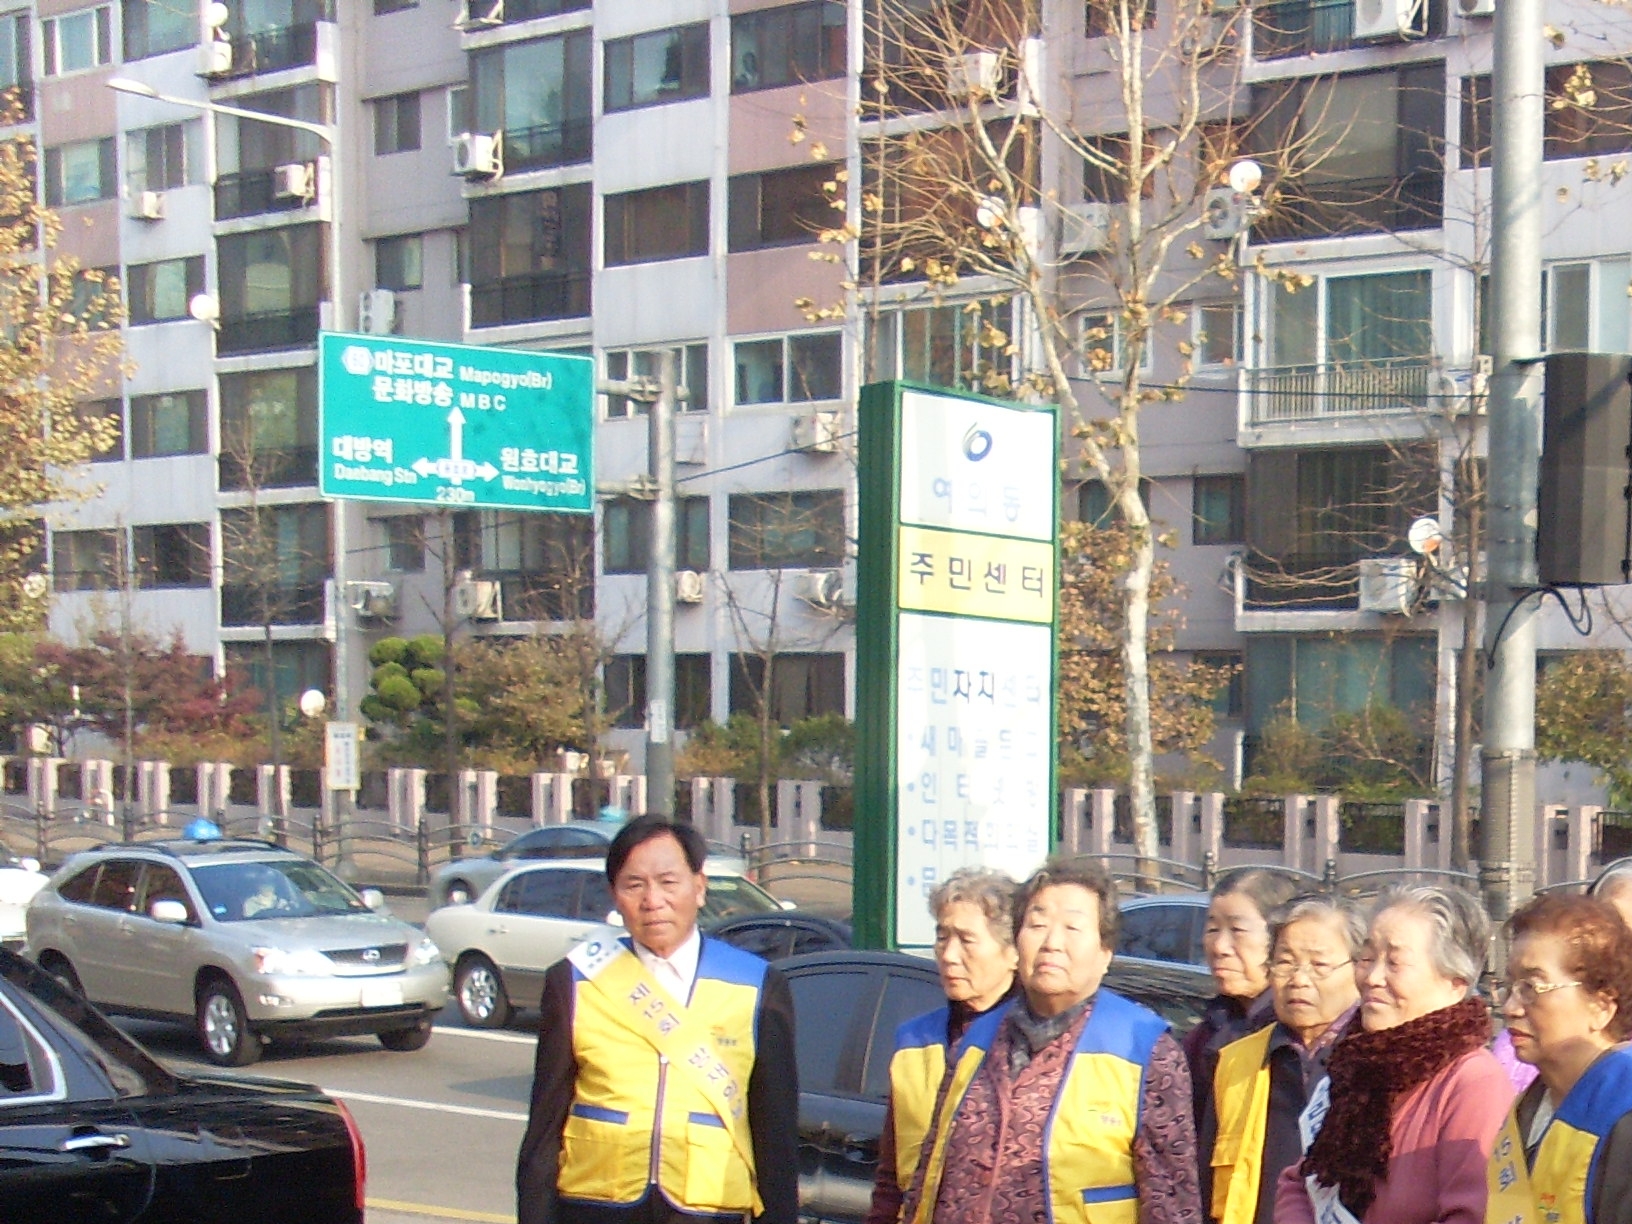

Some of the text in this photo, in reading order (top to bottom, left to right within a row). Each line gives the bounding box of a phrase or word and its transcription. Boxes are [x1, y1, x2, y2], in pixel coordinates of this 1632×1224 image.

[374, 349, 553, 390] 마포대교 Mapogyo(Br)
[373, 375, 507, 411] 문화방송 MBC
[332, 435, 394, 464] 대방역
[910, 552, 1043, 598] 주민센터
